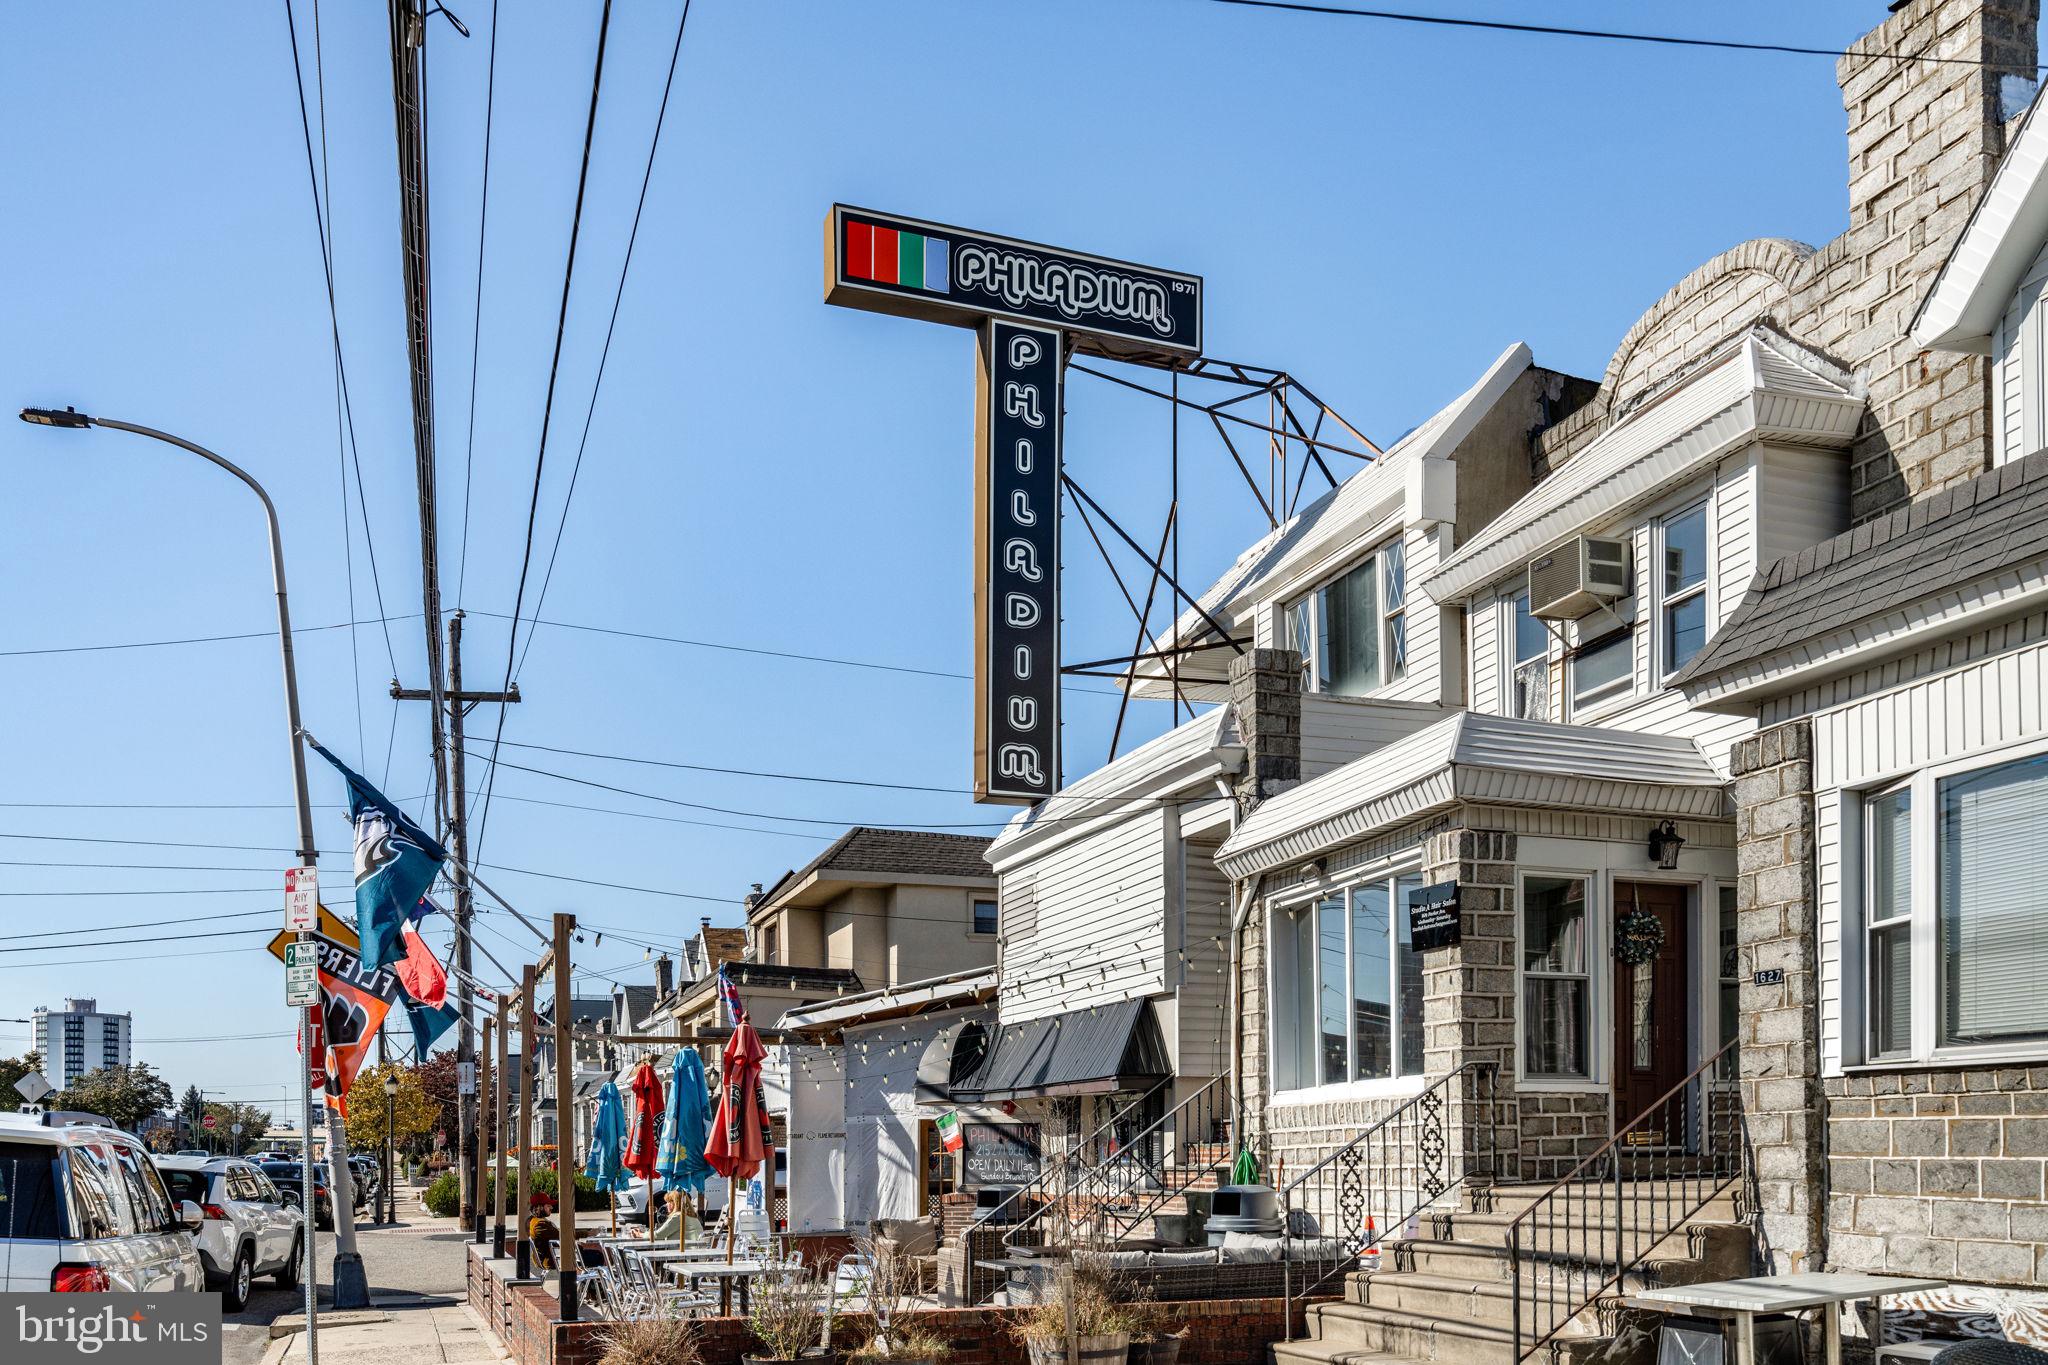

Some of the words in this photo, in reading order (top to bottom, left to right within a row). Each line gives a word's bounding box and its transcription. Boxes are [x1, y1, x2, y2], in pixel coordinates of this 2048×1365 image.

[1172, 281, 1195, 295] 1971
[286, 875, 295, 887] NO
[293, 893, 308, 903] ANY
[293, 904, 309, 915] TIME
[287, 949, 294, 965] 2
[295, 955, 315, 964] PARKING
[1755, 970, 1781, 983] 1627
[968, 1159, 990, 1171] OPEN
[994, 1159, 1015, 1171] DAILY
[980, 1172, 1004, 1183] Sunday
